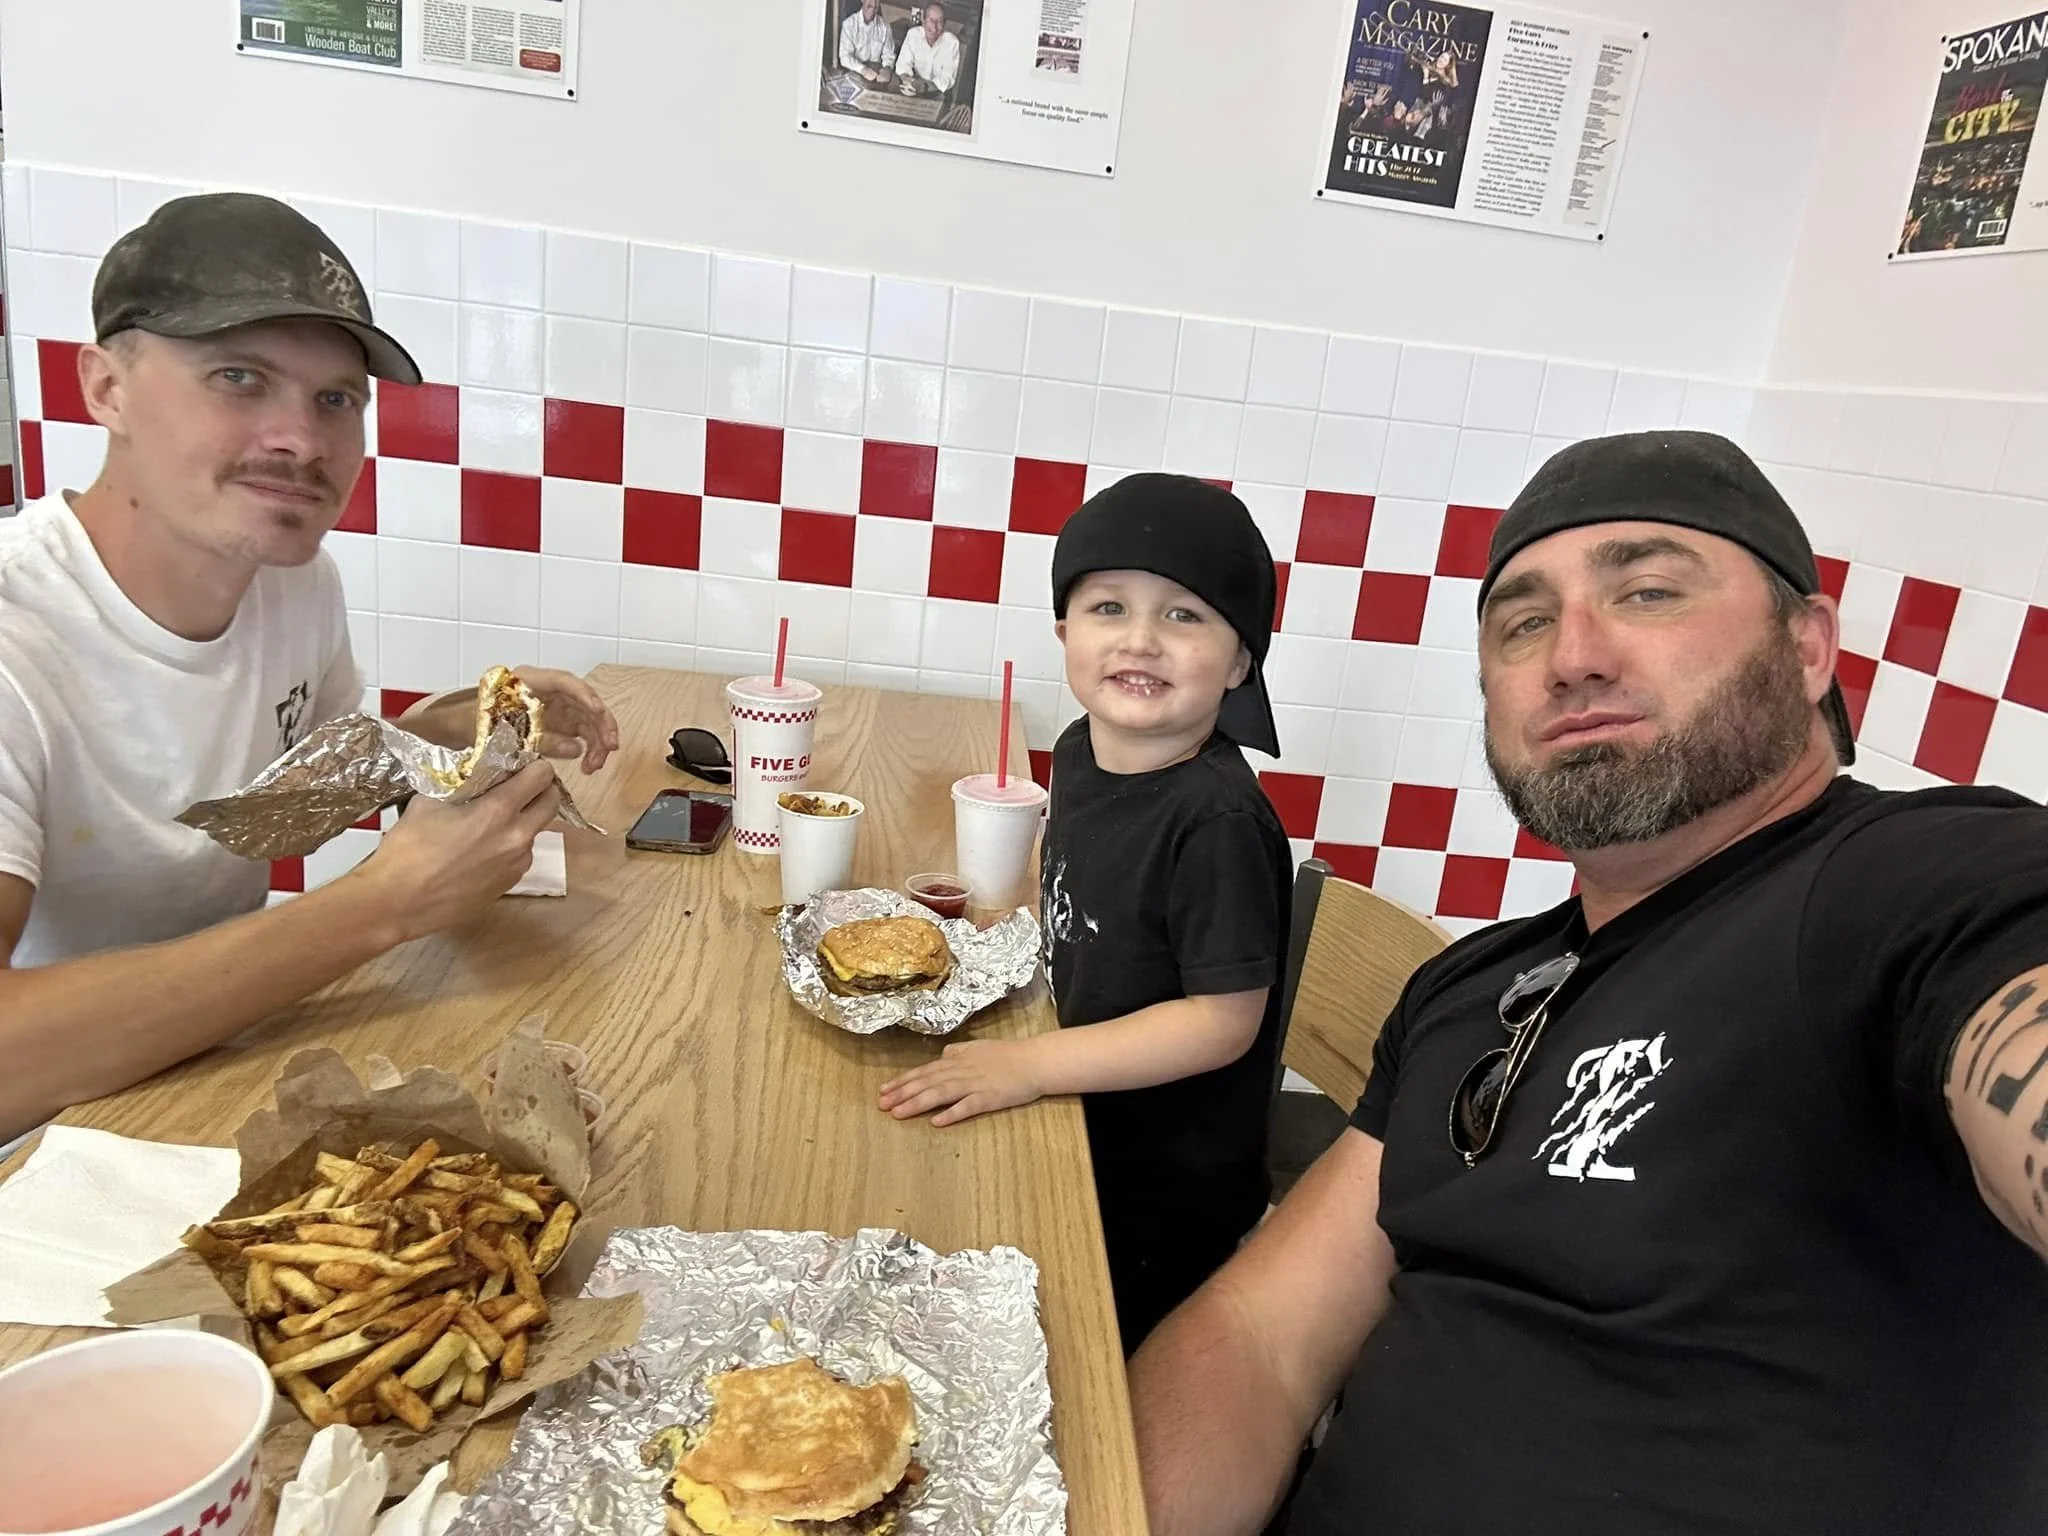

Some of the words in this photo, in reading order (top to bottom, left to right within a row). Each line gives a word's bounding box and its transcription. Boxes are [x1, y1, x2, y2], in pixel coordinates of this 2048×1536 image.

[373, 20, 397, 32] MORE!
[1387, 0, 1456, 35] CARY
[304, 33, 345, 52] Wooden
[348, 39, 371, 55] Boat
[374, 42, 397, 59] Club
[1358, 17, 1478, 63] MAGAZINE
[1941, 13, 2048, 74] SPOKAN
[1034, 101, 1051, 110] brand
[1051, 104, 1064, 112] with
[1064, 106, 1074, 114] the
[1945, 98, 2021, 144] CITY
[1347, 136, 1448, 168] GREATEST
[1343, 154, 1388, 177] HITS
[750, 756, 795, 771] FIVE
[761, 774, 798, 782] BURGERS
